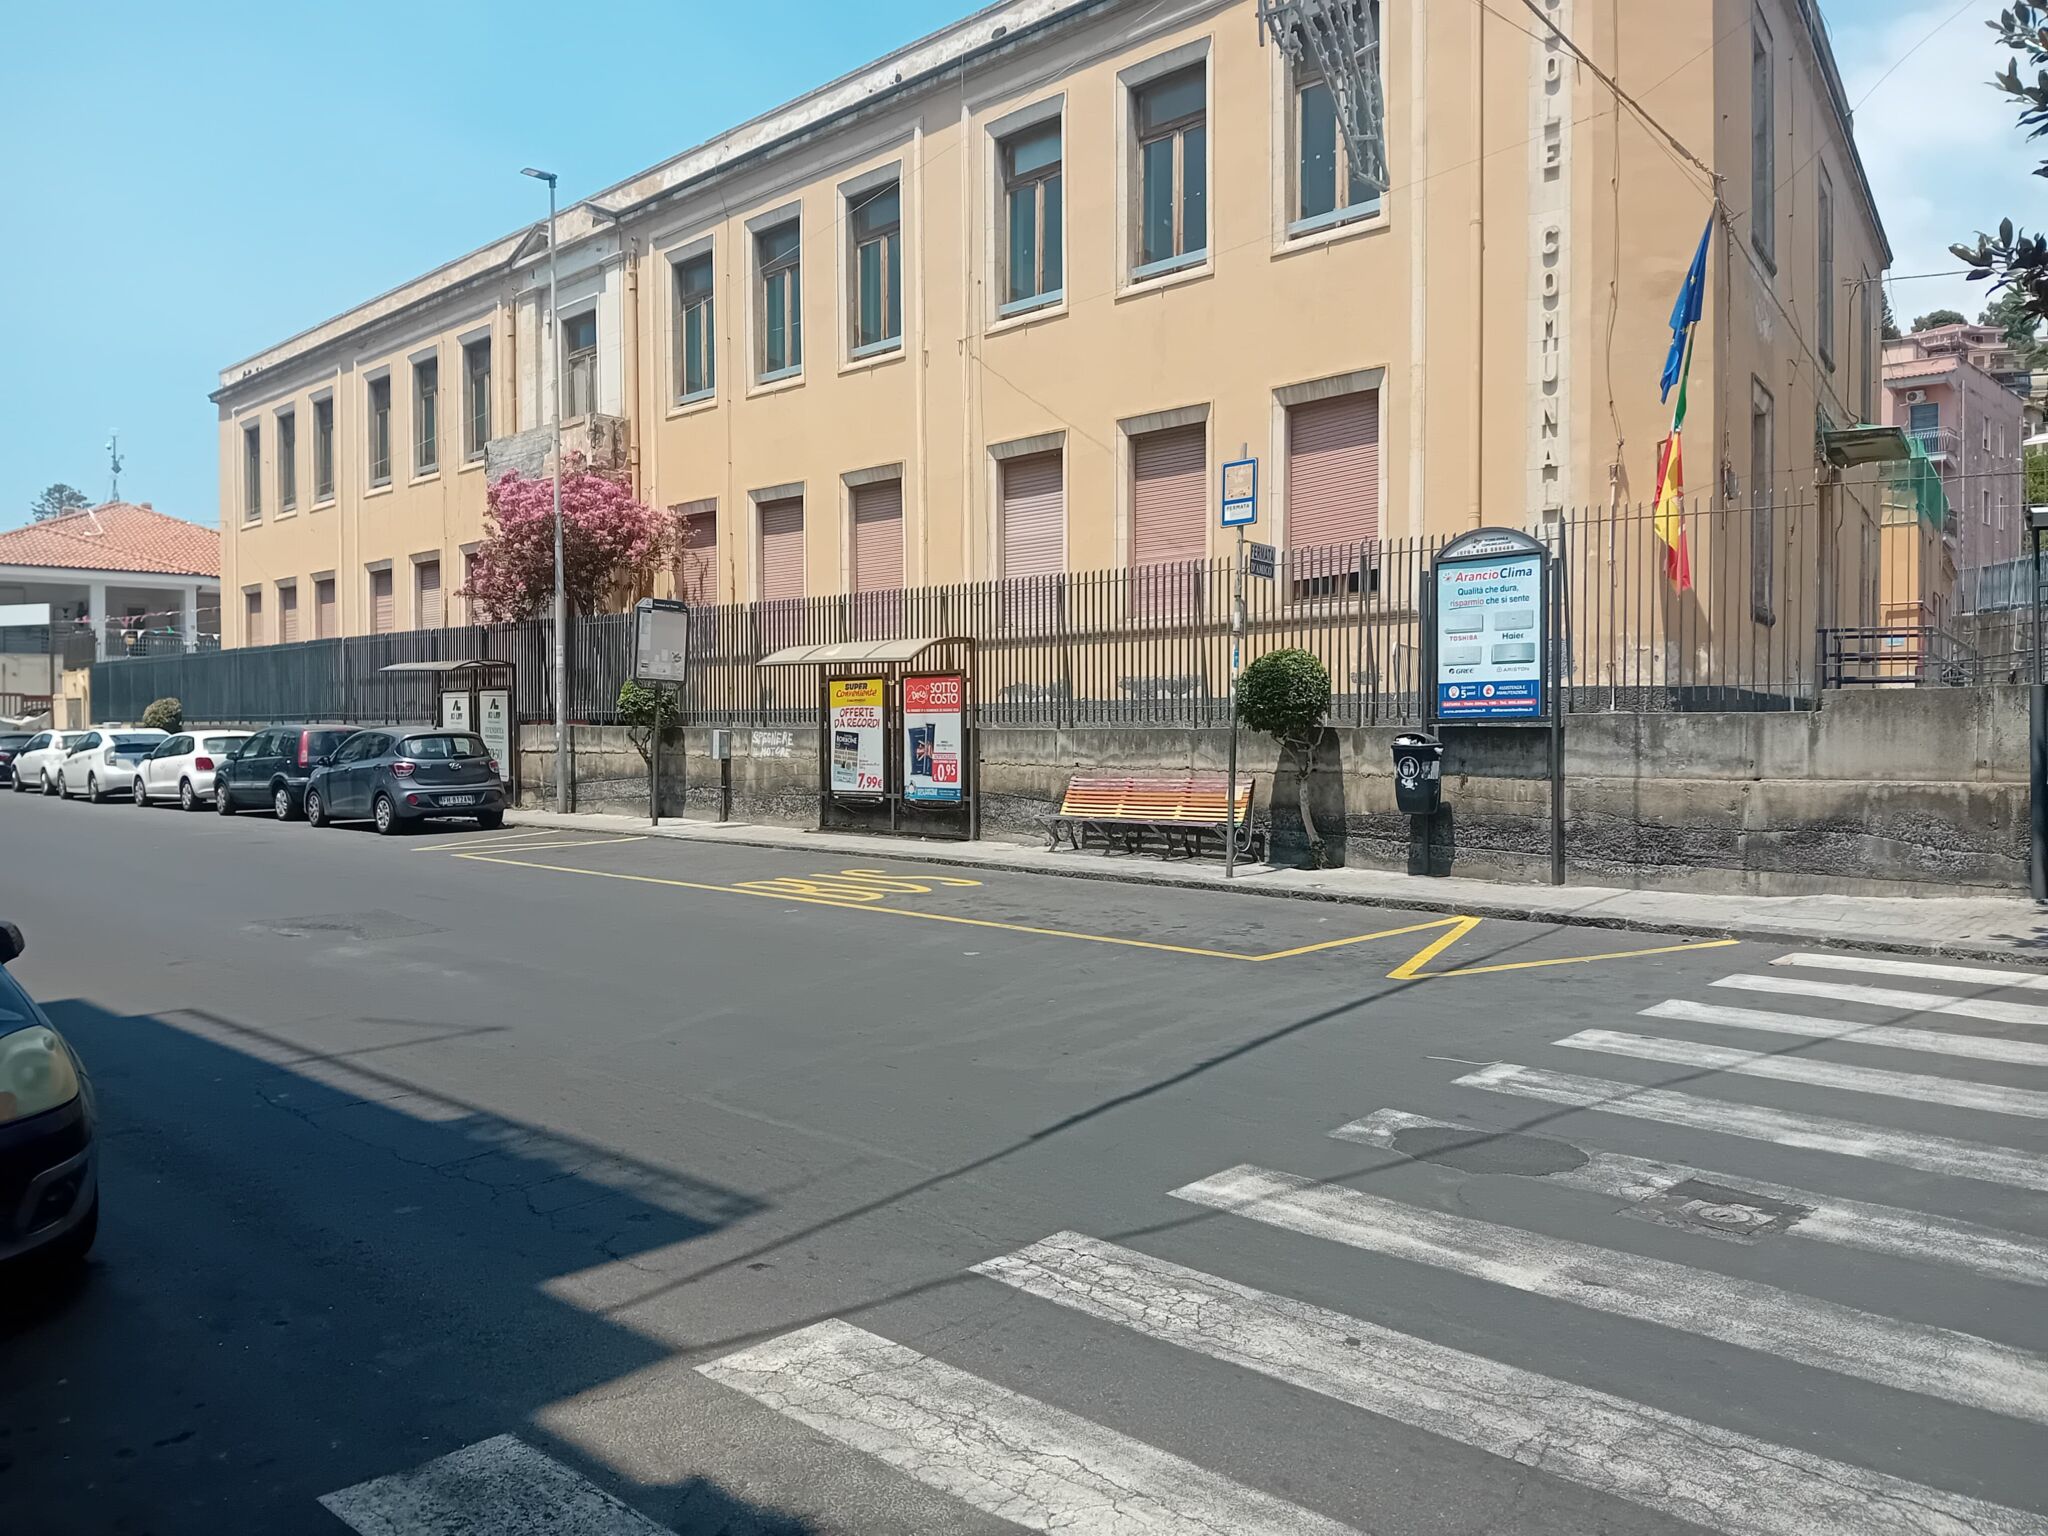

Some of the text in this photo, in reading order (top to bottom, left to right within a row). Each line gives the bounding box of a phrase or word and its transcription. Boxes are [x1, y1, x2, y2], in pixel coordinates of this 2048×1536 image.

[1226, 503, 1250, 511] FERMATA
[1251, 544, 1275, 562] FERMATA
[1455, 567, 1533, 582] ArancioClima
[1457, 584, 1519, 596] Qualità che dura,
[1450, 594, 1530, 608] risparmio che si sente
[1450, 631, 1524, 642] TOSHIBA Haier
[836, 688, 878, 698] Conveniente
[930, 682, 959, 694] SOTTO
[929, 693, 959, 705] COSTO
[1460, 690, 1467, 699] 5
[840, 707, 875, 718] OFFERTE
[834, 719, 846, 729] DA
[760, 746, 792, 758] MOTORE
[731, 869, 983, 901] BUS
